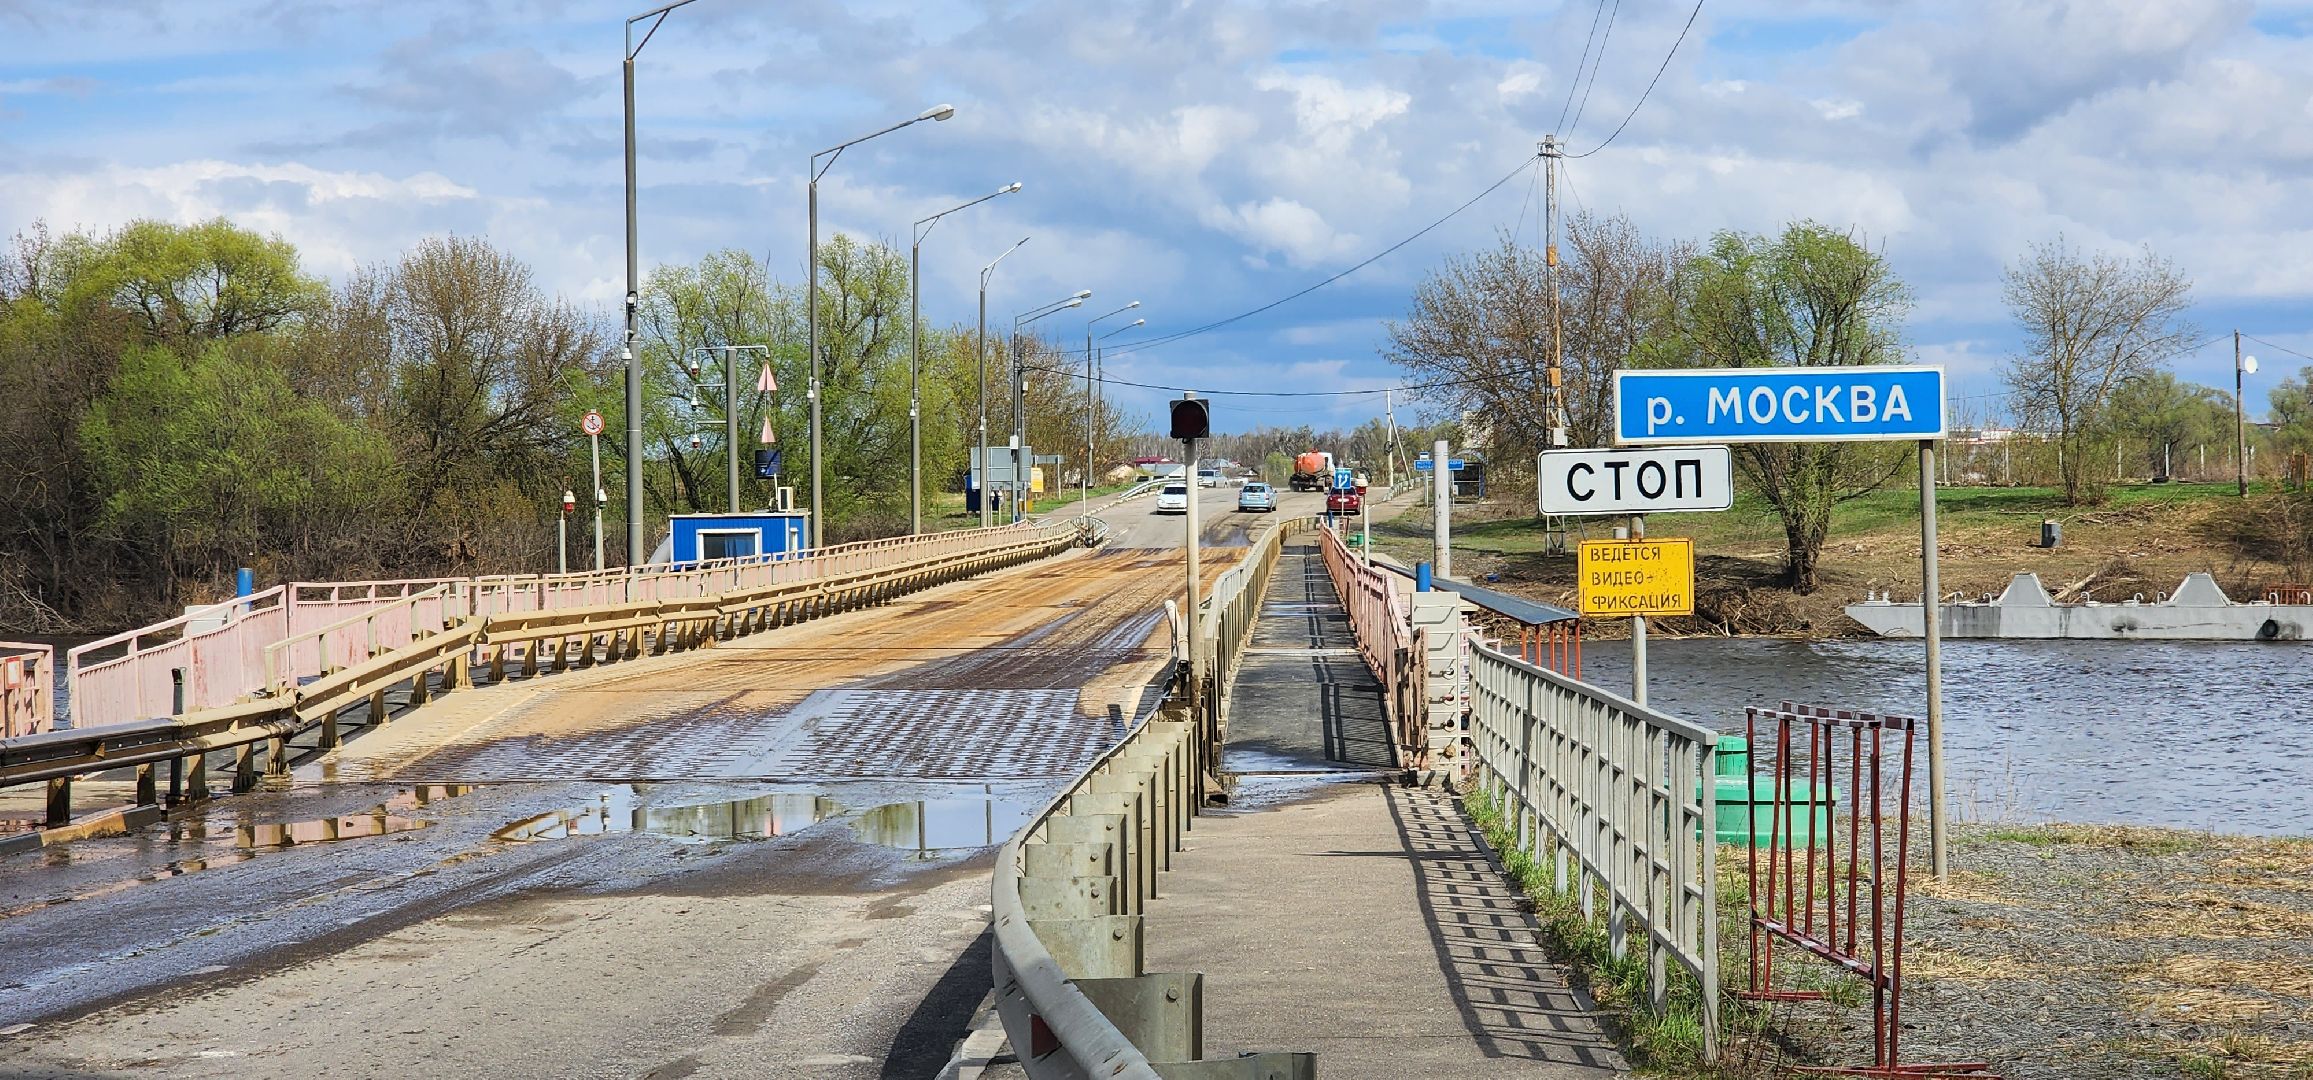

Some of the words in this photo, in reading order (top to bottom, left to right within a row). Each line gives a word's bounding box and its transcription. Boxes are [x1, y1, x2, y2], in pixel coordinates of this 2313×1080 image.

[1647, 396, 1685, 435] р.
[1707, 385, 1913, 424] МОСКВА
[1566, 460, 1702, 502] СТОП
[1590, 545, 1661, 563] ВЕДЁТСЯ
[1591, 571, 1654, 587] ВИДЕО-
[1592, 594, 1681, 610] ФИКСАЦИЯ
